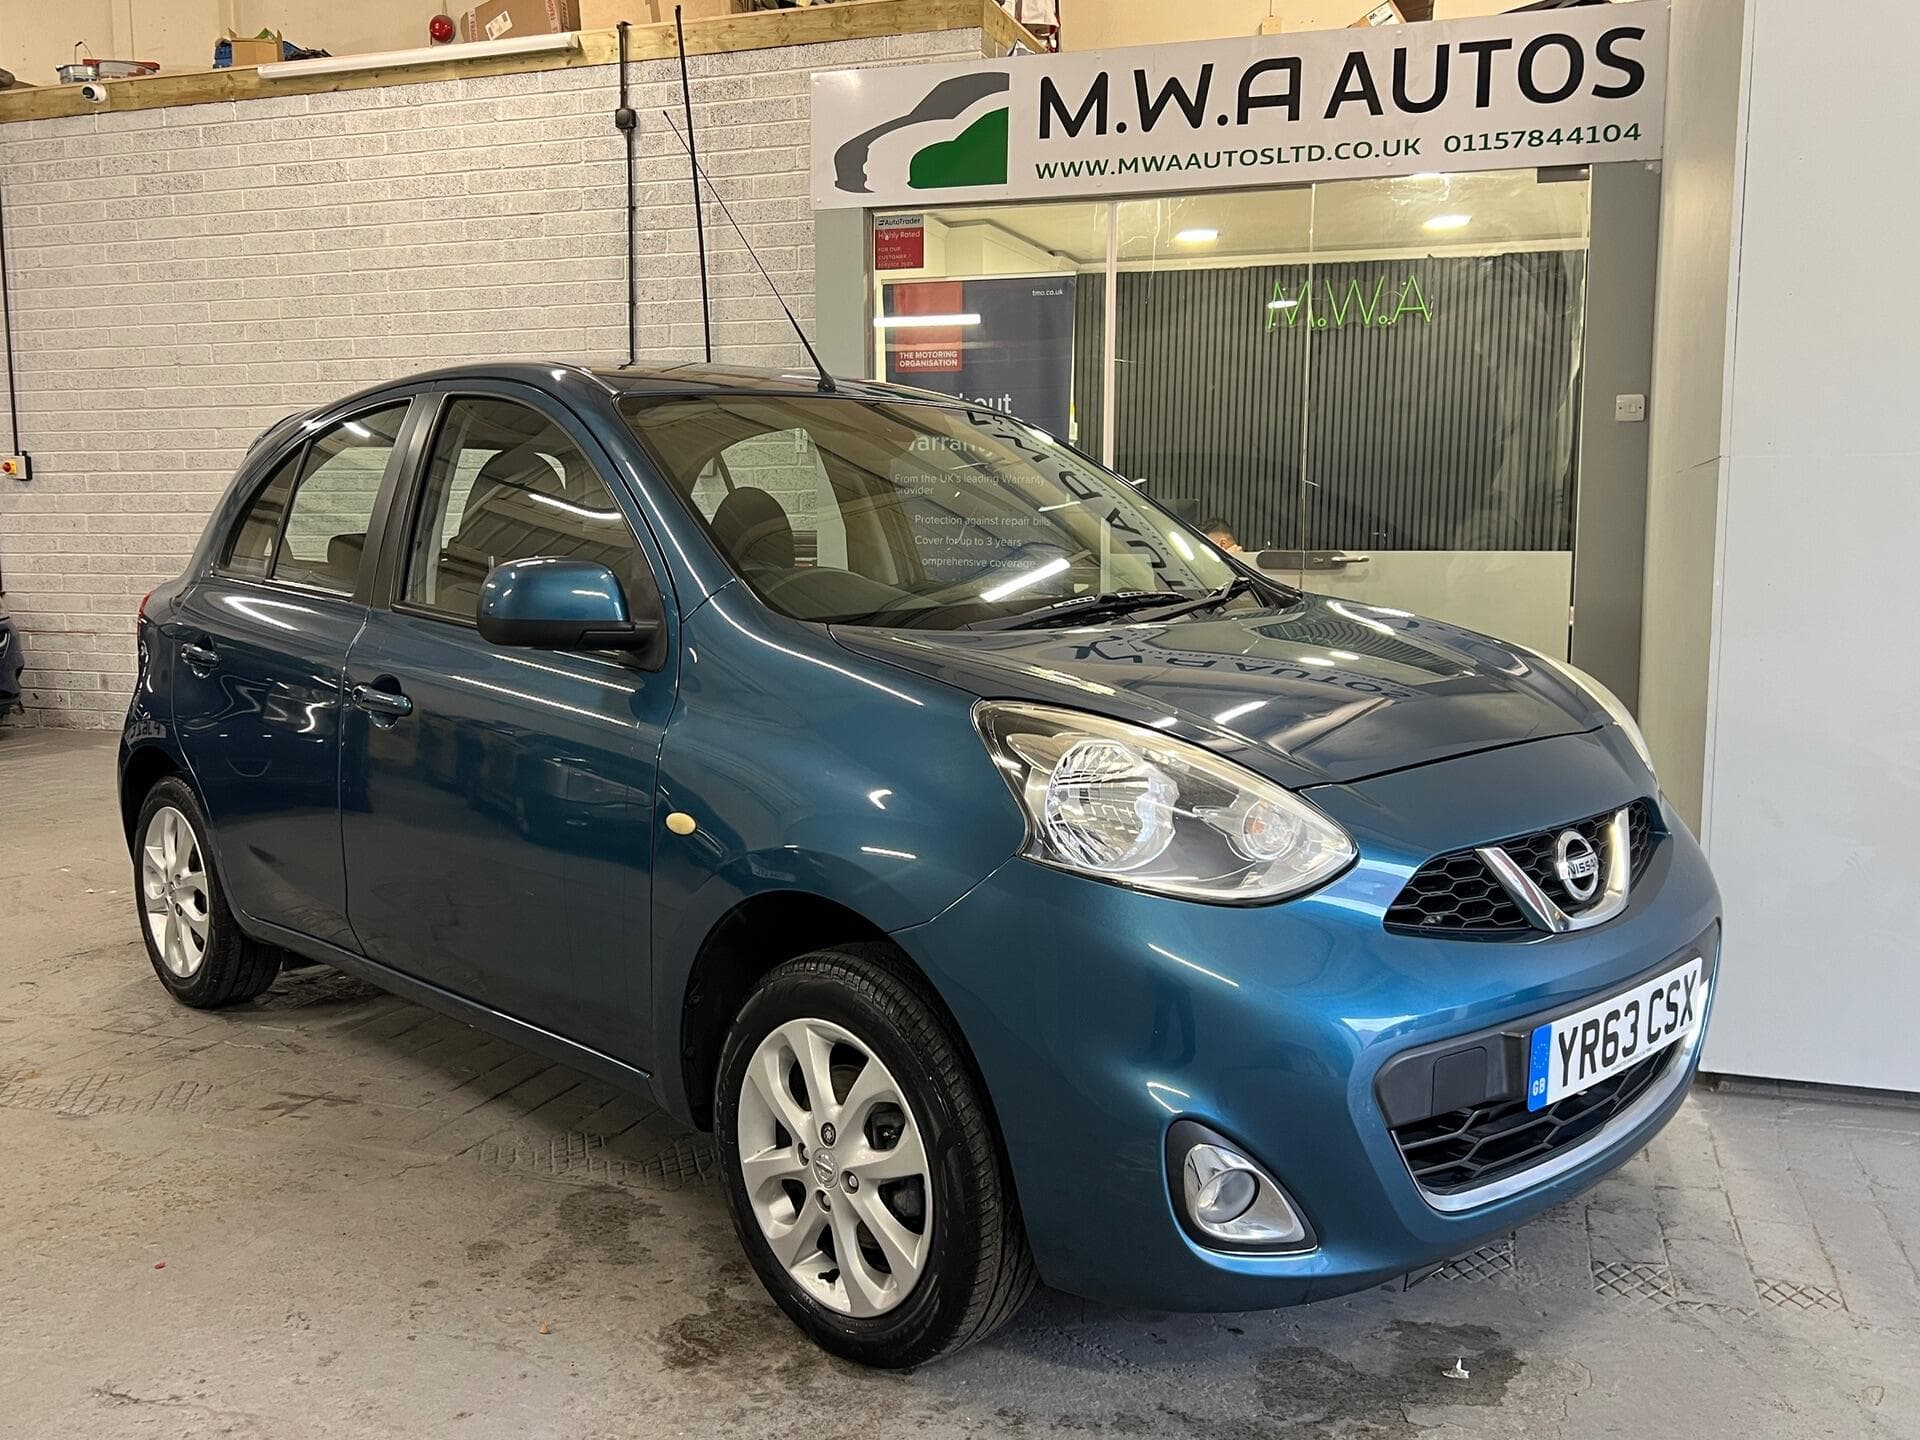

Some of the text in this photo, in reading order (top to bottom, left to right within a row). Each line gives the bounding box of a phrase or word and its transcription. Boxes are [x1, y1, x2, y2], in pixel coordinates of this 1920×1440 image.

[1039, 27, 1646, 140] M.W.A AUTOS
[1036, 123, 1642, 180] WWW.MWAAUTOSLTD.CO.UK 01157844104
[1267, 274, 1432, 329] M.W.A
[900, 350, 958, 359] THE MOTORING
[899, 359, 958, 368] ORGANISATION
[895, 473, 1045, 487] From the UK's leading Warranty
[915, 514, 1051, 528] Protection against repair bills
[914, 535, 943, 545] Cover
[961, 538, 972, 548] up
[974, 537, 984, 546] to
[986, 536, 993, 546] 3
[995, 537, 1022, 548] years
[921, 556, 1036, 569] omprehensive coverage
[1558, 970, 1697, 1087] YR63 CSX
[1532, 1077, 1546, 1097] GB
